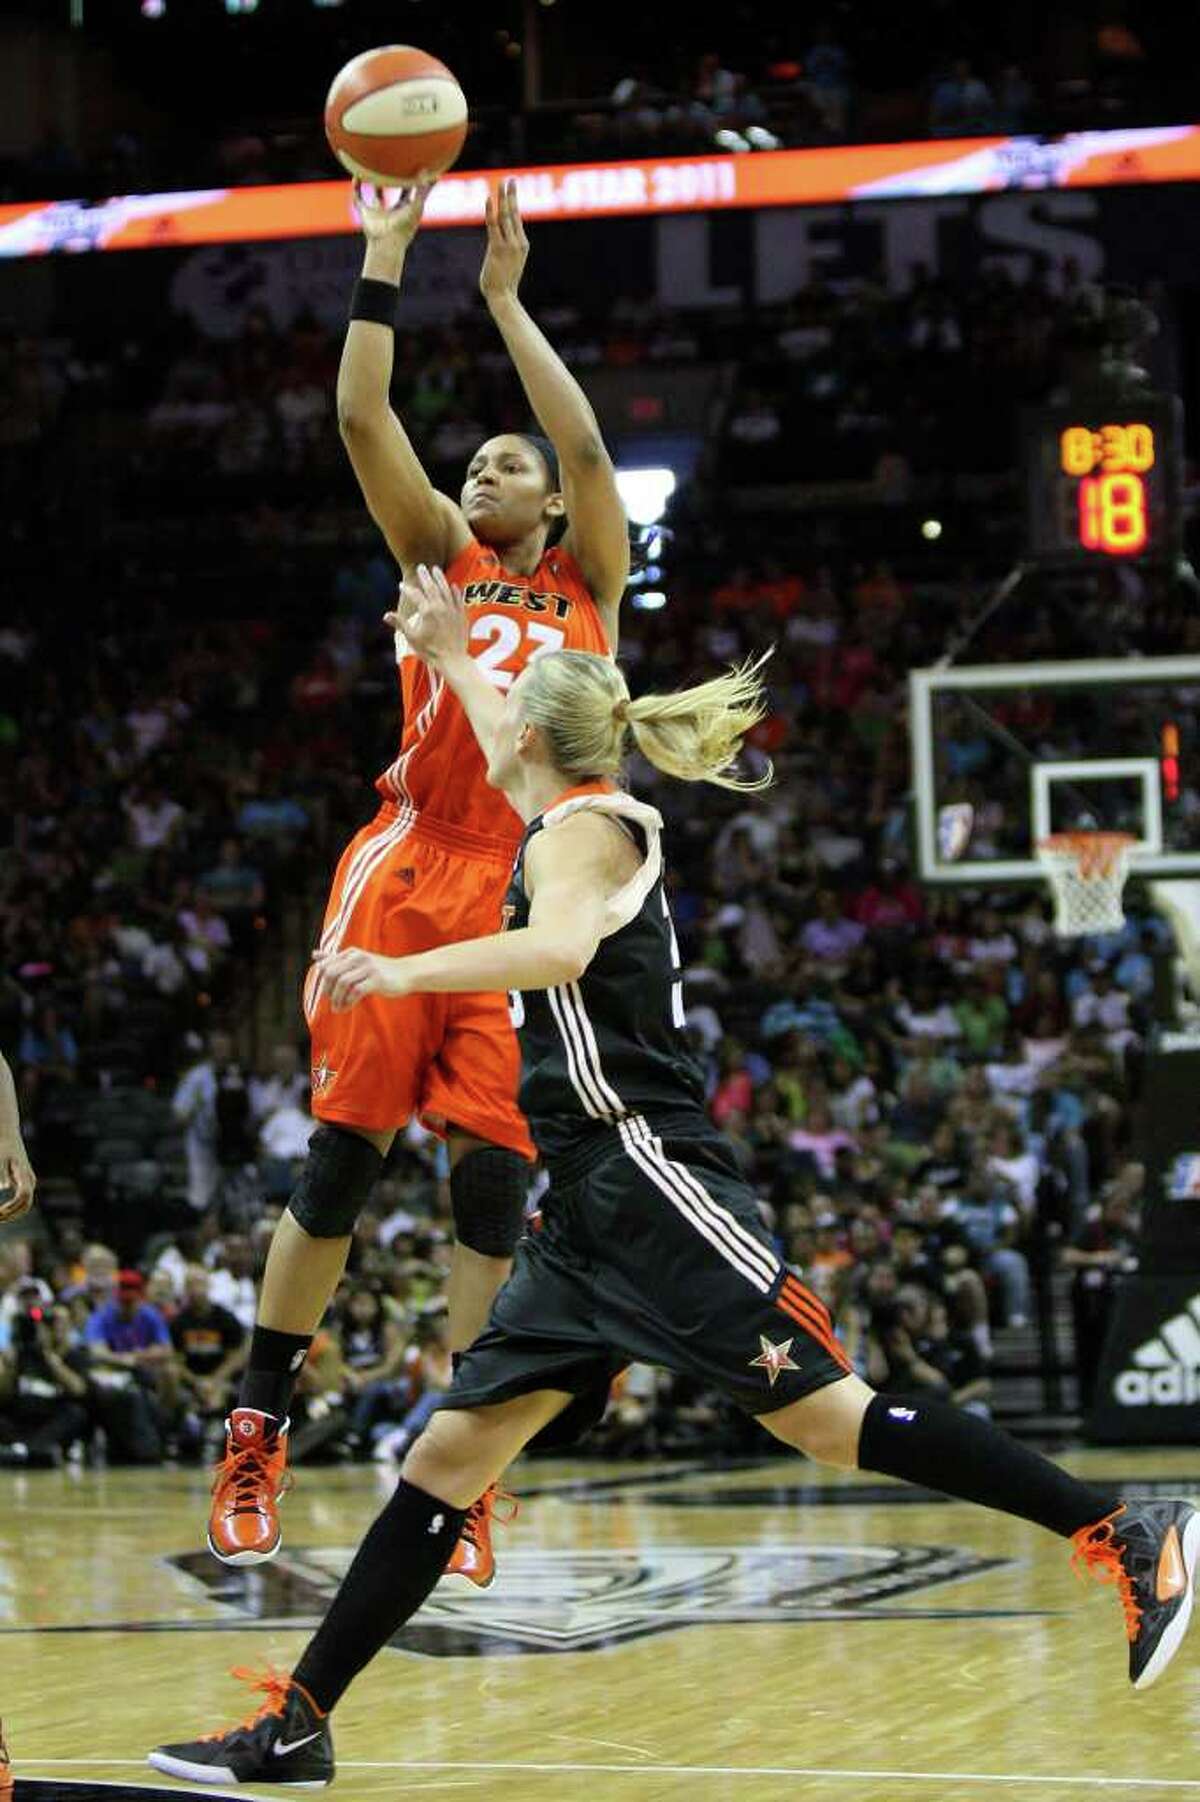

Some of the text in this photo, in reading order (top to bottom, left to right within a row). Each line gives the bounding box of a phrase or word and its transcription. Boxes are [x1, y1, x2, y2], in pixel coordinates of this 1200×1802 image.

[503, 167, 647, 213] LL-STAR
[651, 161, 735, 205] 2011
[656, 192, 1106, 306] LETS
[1061, 423, 1155, 475] 8:30
[1079, 473, 1147, 553] 18
[464, 579, 573, 619] WEST
